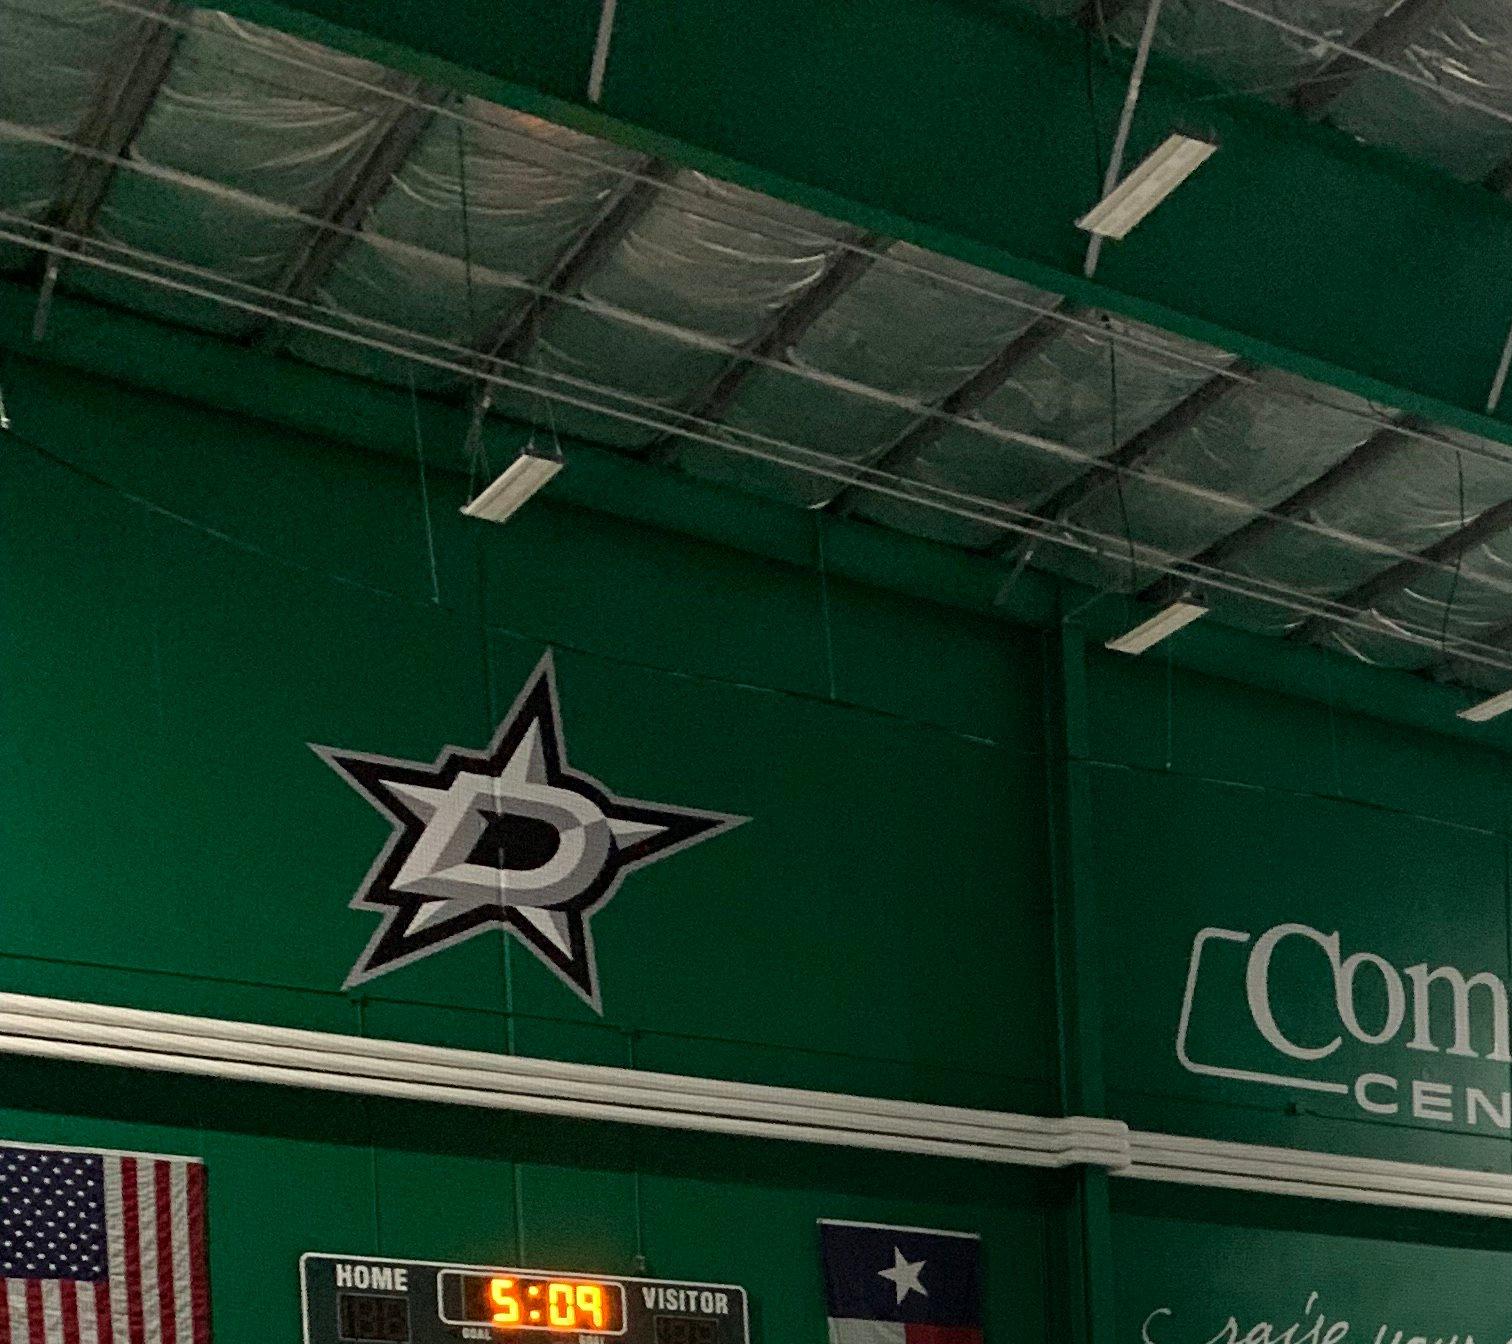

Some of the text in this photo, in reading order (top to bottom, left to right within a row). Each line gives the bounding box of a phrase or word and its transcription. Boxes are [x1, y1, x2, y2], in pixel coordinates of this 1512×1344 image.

[336, 1264, 730, 1328] HOME 5:09 VISITOR
